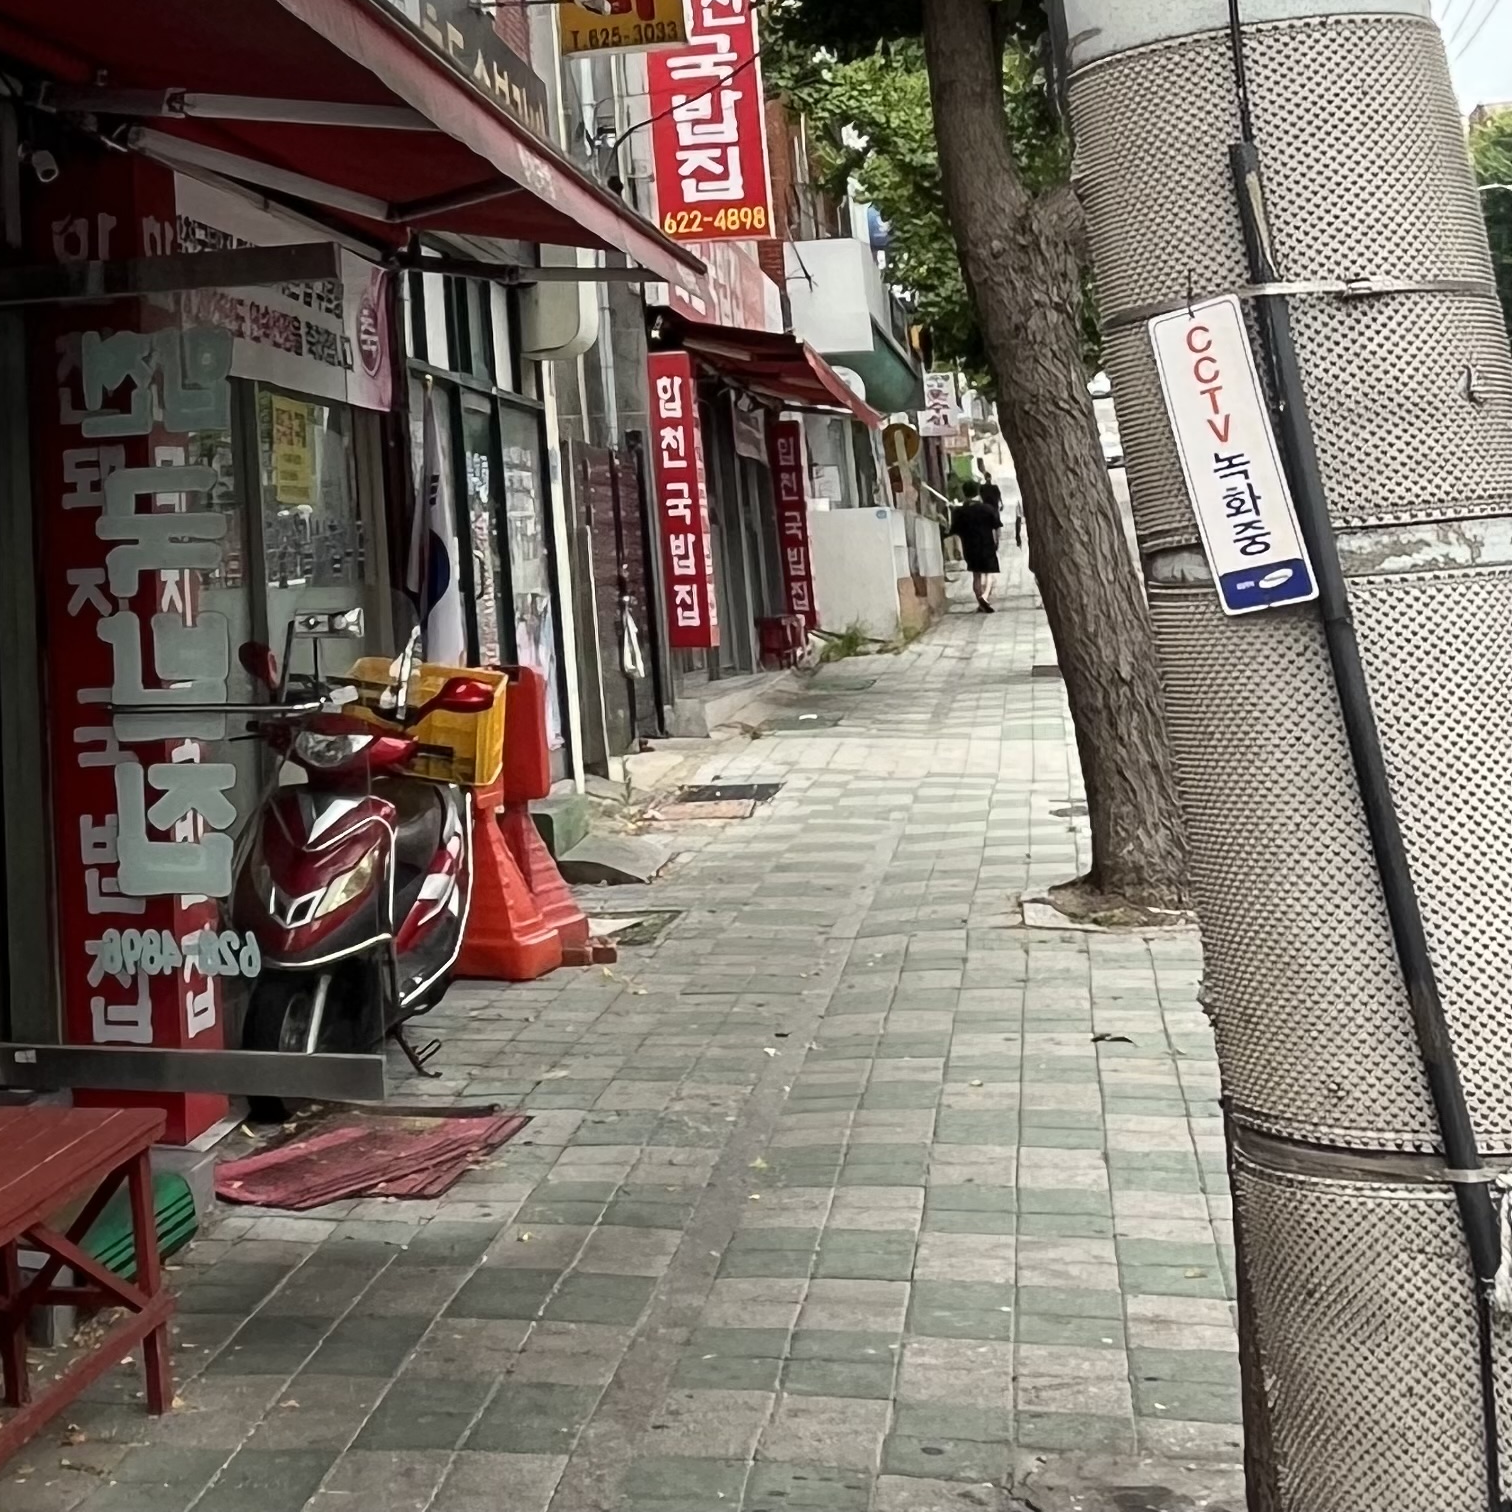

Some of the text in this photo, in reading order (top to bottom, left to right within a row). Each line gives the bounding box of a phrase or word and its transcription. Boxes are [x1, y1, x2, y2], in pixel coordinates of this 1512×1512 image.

[664, 206, 766, 234] 622-4898
[1186, 325, 1231, 443] CCTV
[656, 376, 700, 627] 합천국밥집
[1213, 453, 1271, 556] 녹화중
